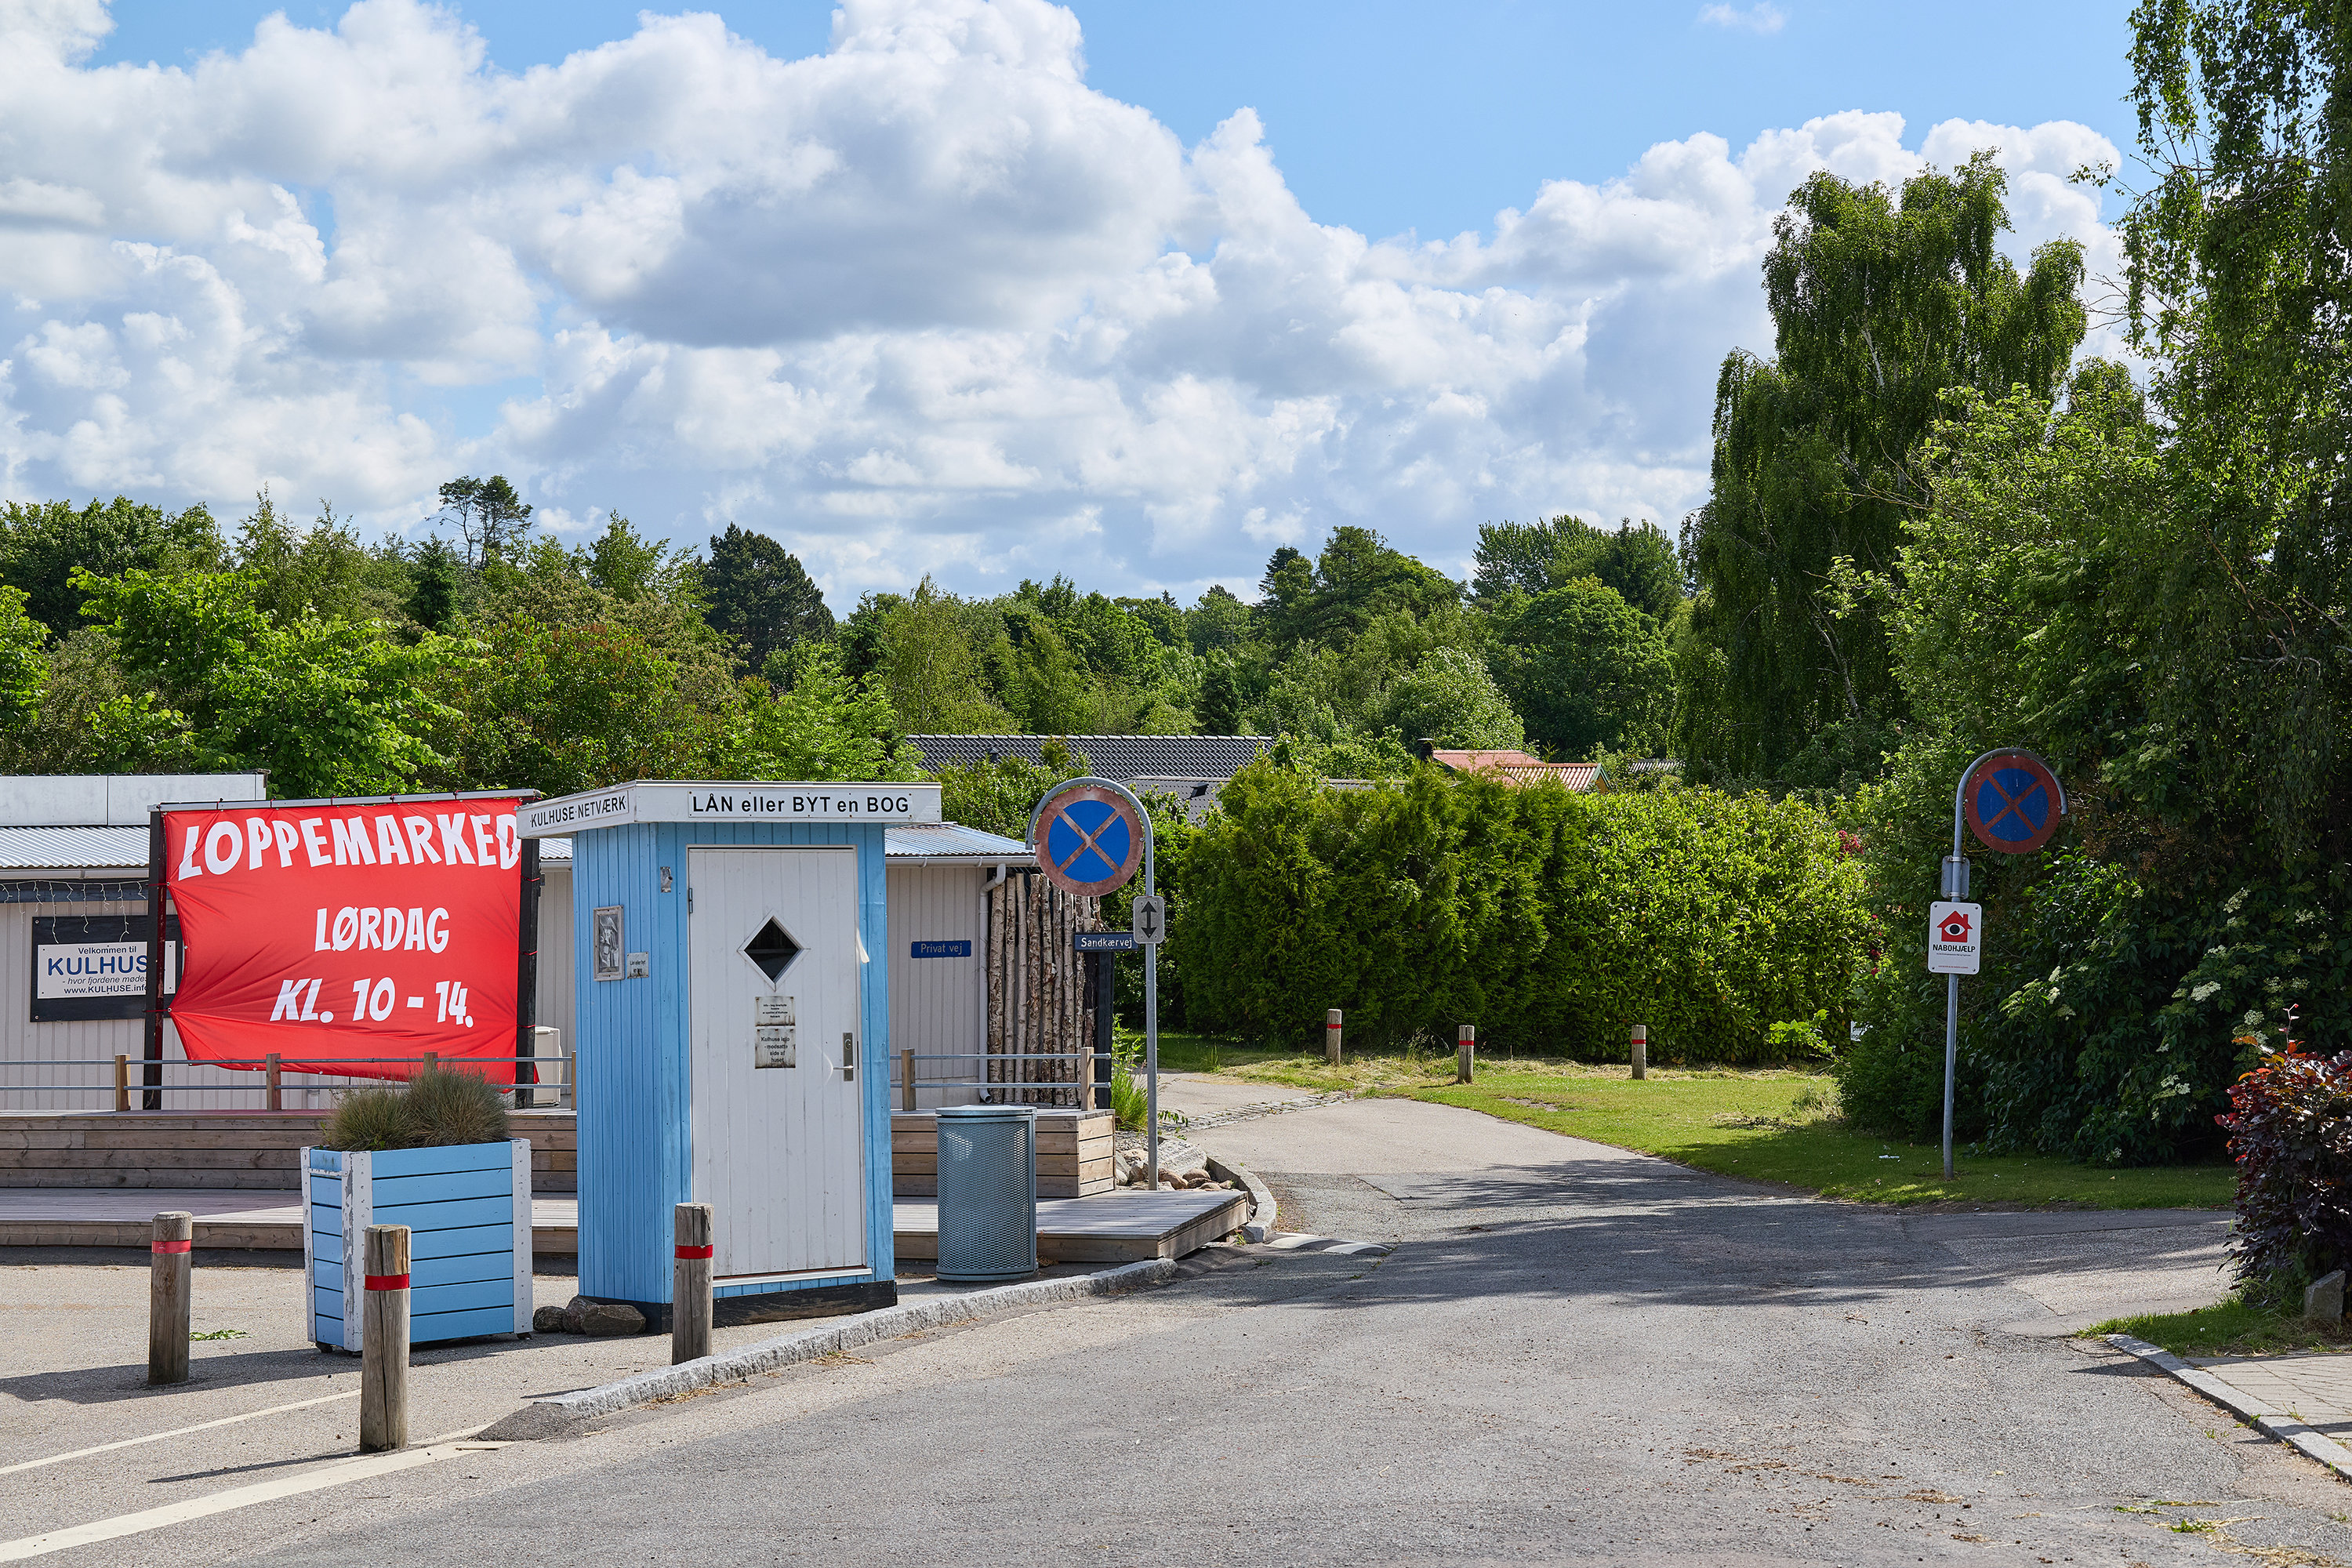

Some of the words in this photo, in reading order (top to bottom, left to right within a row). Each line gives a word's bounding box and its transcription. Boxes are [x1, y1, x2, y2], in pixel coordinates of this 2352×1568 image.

[531, 806, 575, 828] KULHUSE
[578, 795, 626, 818] NETVÆRK
[693, 793, 732, 812] LÅN
[742, 797, 784, 812] eller
[793, 797, 830, 812] BYT
[837, 800, 858, 812] en
[867, 797, 909, 812] BOG
[178, 813, 522, 882] LOPPEMARKED
[314, 906, 450, 954] LØRDAG
[920, 943, 946, 953] Privat
[949, 942, 962, 955] vej
[1080, 937, 1132, 949] Sandkærvej
[1933, 944, 1976, 953] NABOHJÆLP
[48, 955, 147, 976] KULHUS
[87, 975, 121, 985] fjordene
[270, 978, 335, 1024] KL.
[352, 977, 395, 1022] 10
[406, 996, 424, 1009] -
[435, 980, 474, 1029] 14.
